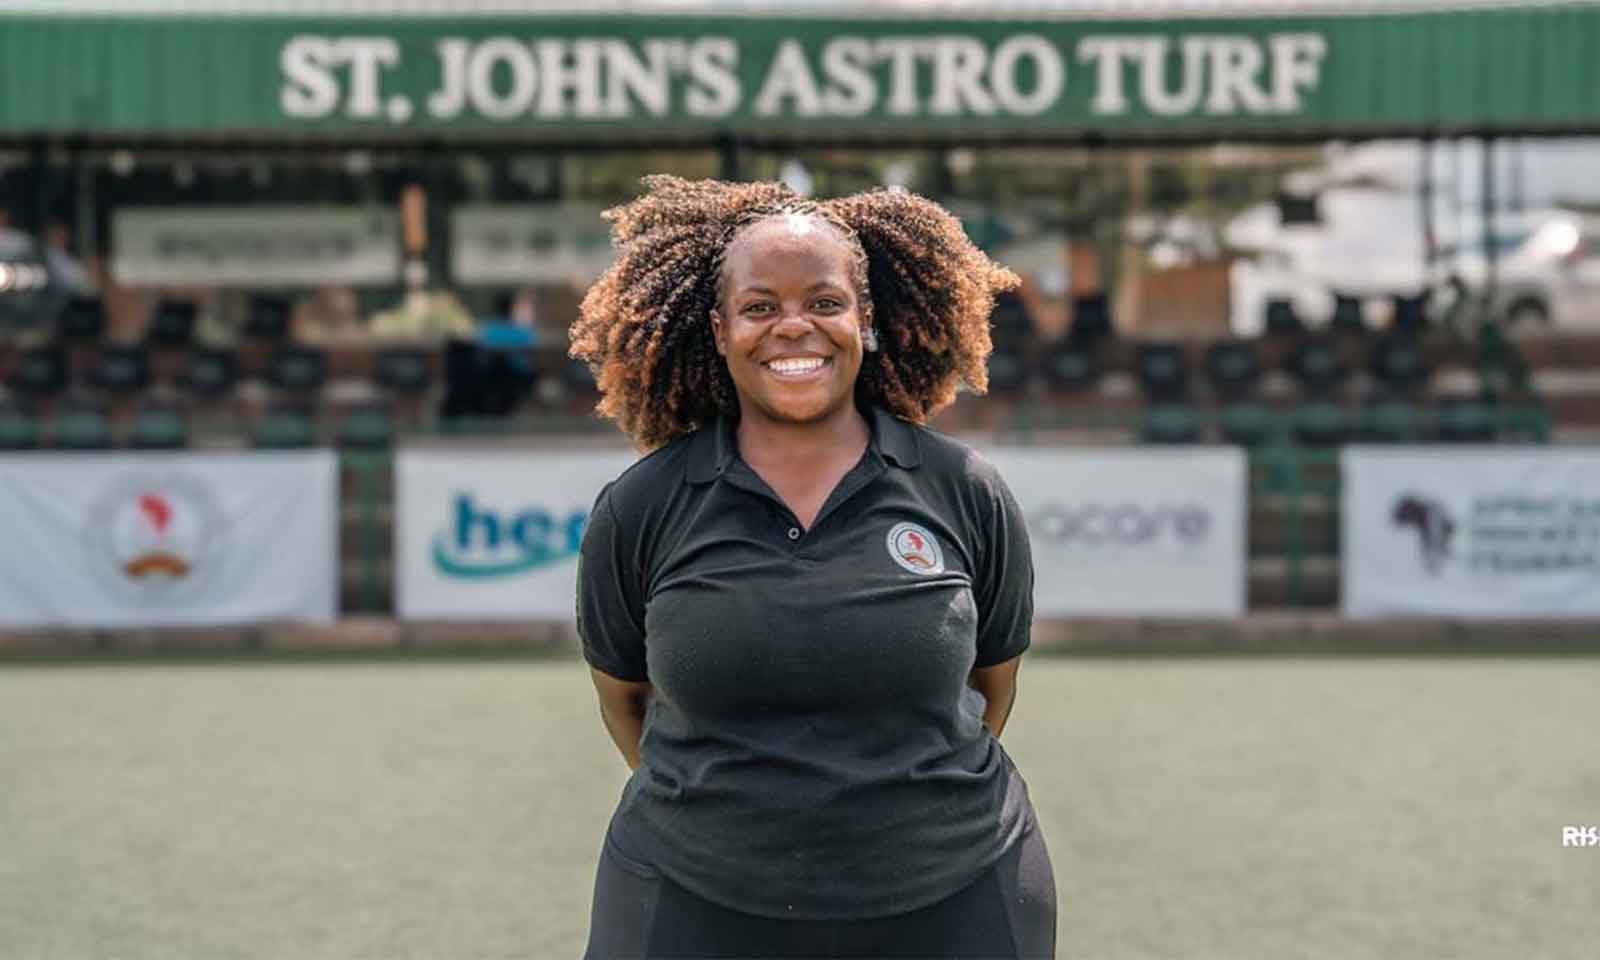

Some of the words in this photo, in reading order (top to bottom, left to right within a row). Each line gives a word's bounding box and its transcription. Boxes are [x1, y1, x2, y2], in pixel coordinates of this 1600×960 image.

[281, 36, 410, 121] ST.
[428, 37, 739, 118] JOHN'S
[756, 36, 1062, 116] ASTRO
[1079, 34, 1326, 115] TURF
